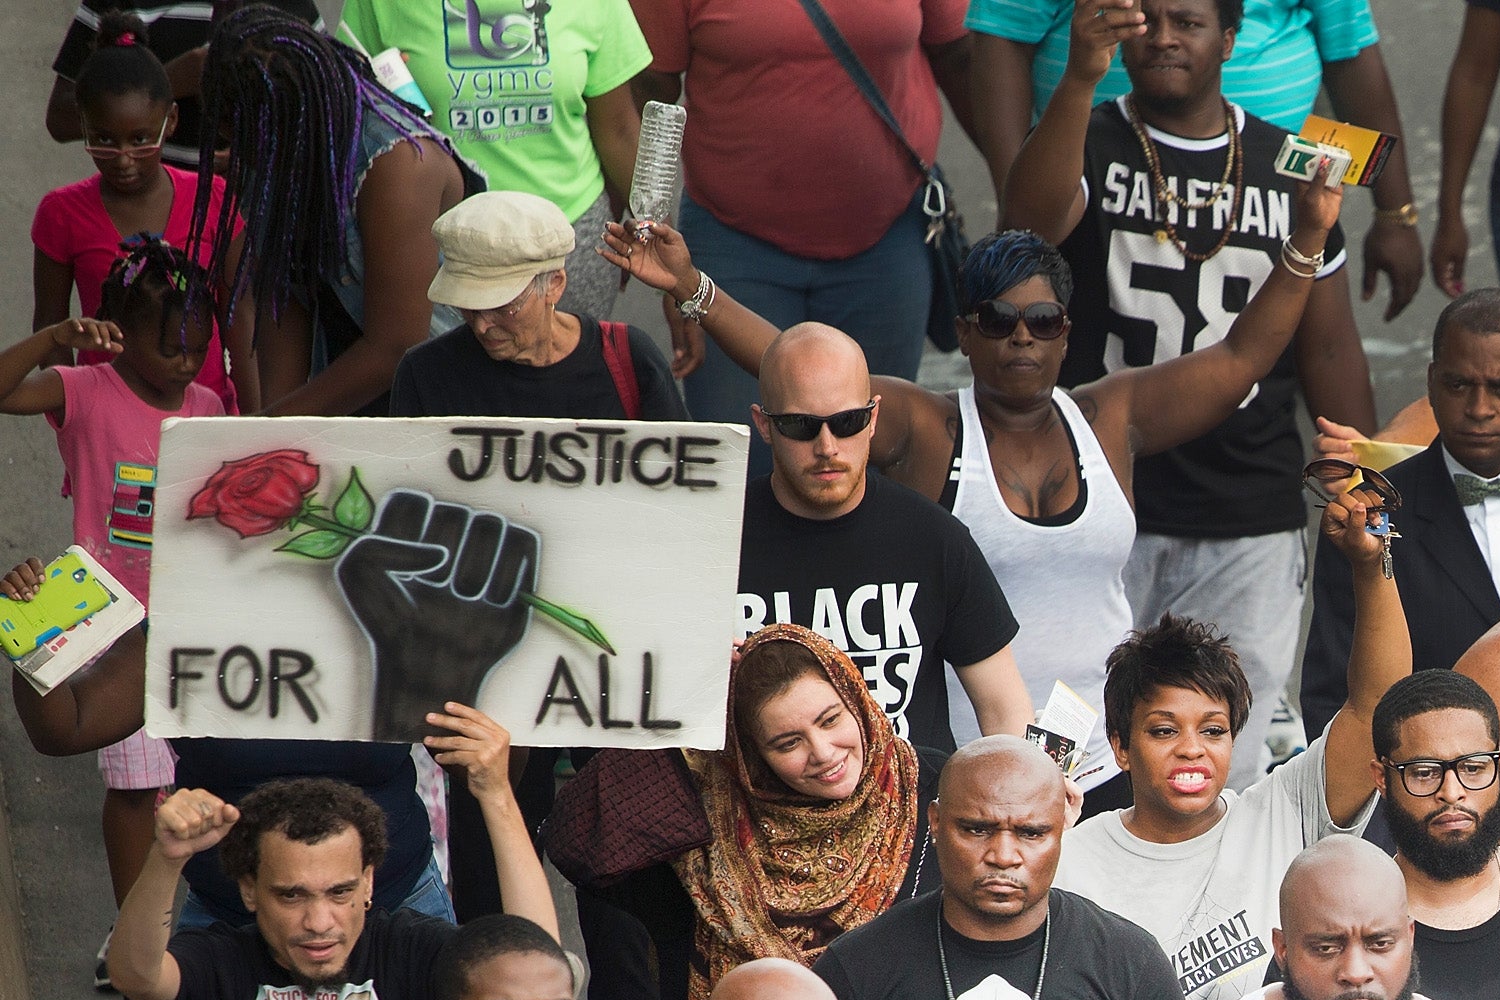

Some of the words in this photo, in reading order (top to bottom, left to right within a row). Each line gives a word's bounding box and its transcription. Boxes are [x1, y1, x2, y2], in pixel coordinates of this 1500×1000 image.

[447, 69, 553, 100] ygmc
[1102, 161, 1179, 223] SAN
[1187, 178, 1291, 242] FRAN
[1103, 229, 1275, 376] 58
[448, 426, 720, 488] JUSTICE
[169, 646, 319, 723] FOR
[534, 651, 681, 730] ALL
[1183, 963, 1217, 995] ACK
[1216, 940, 1260, 972] LIVES
